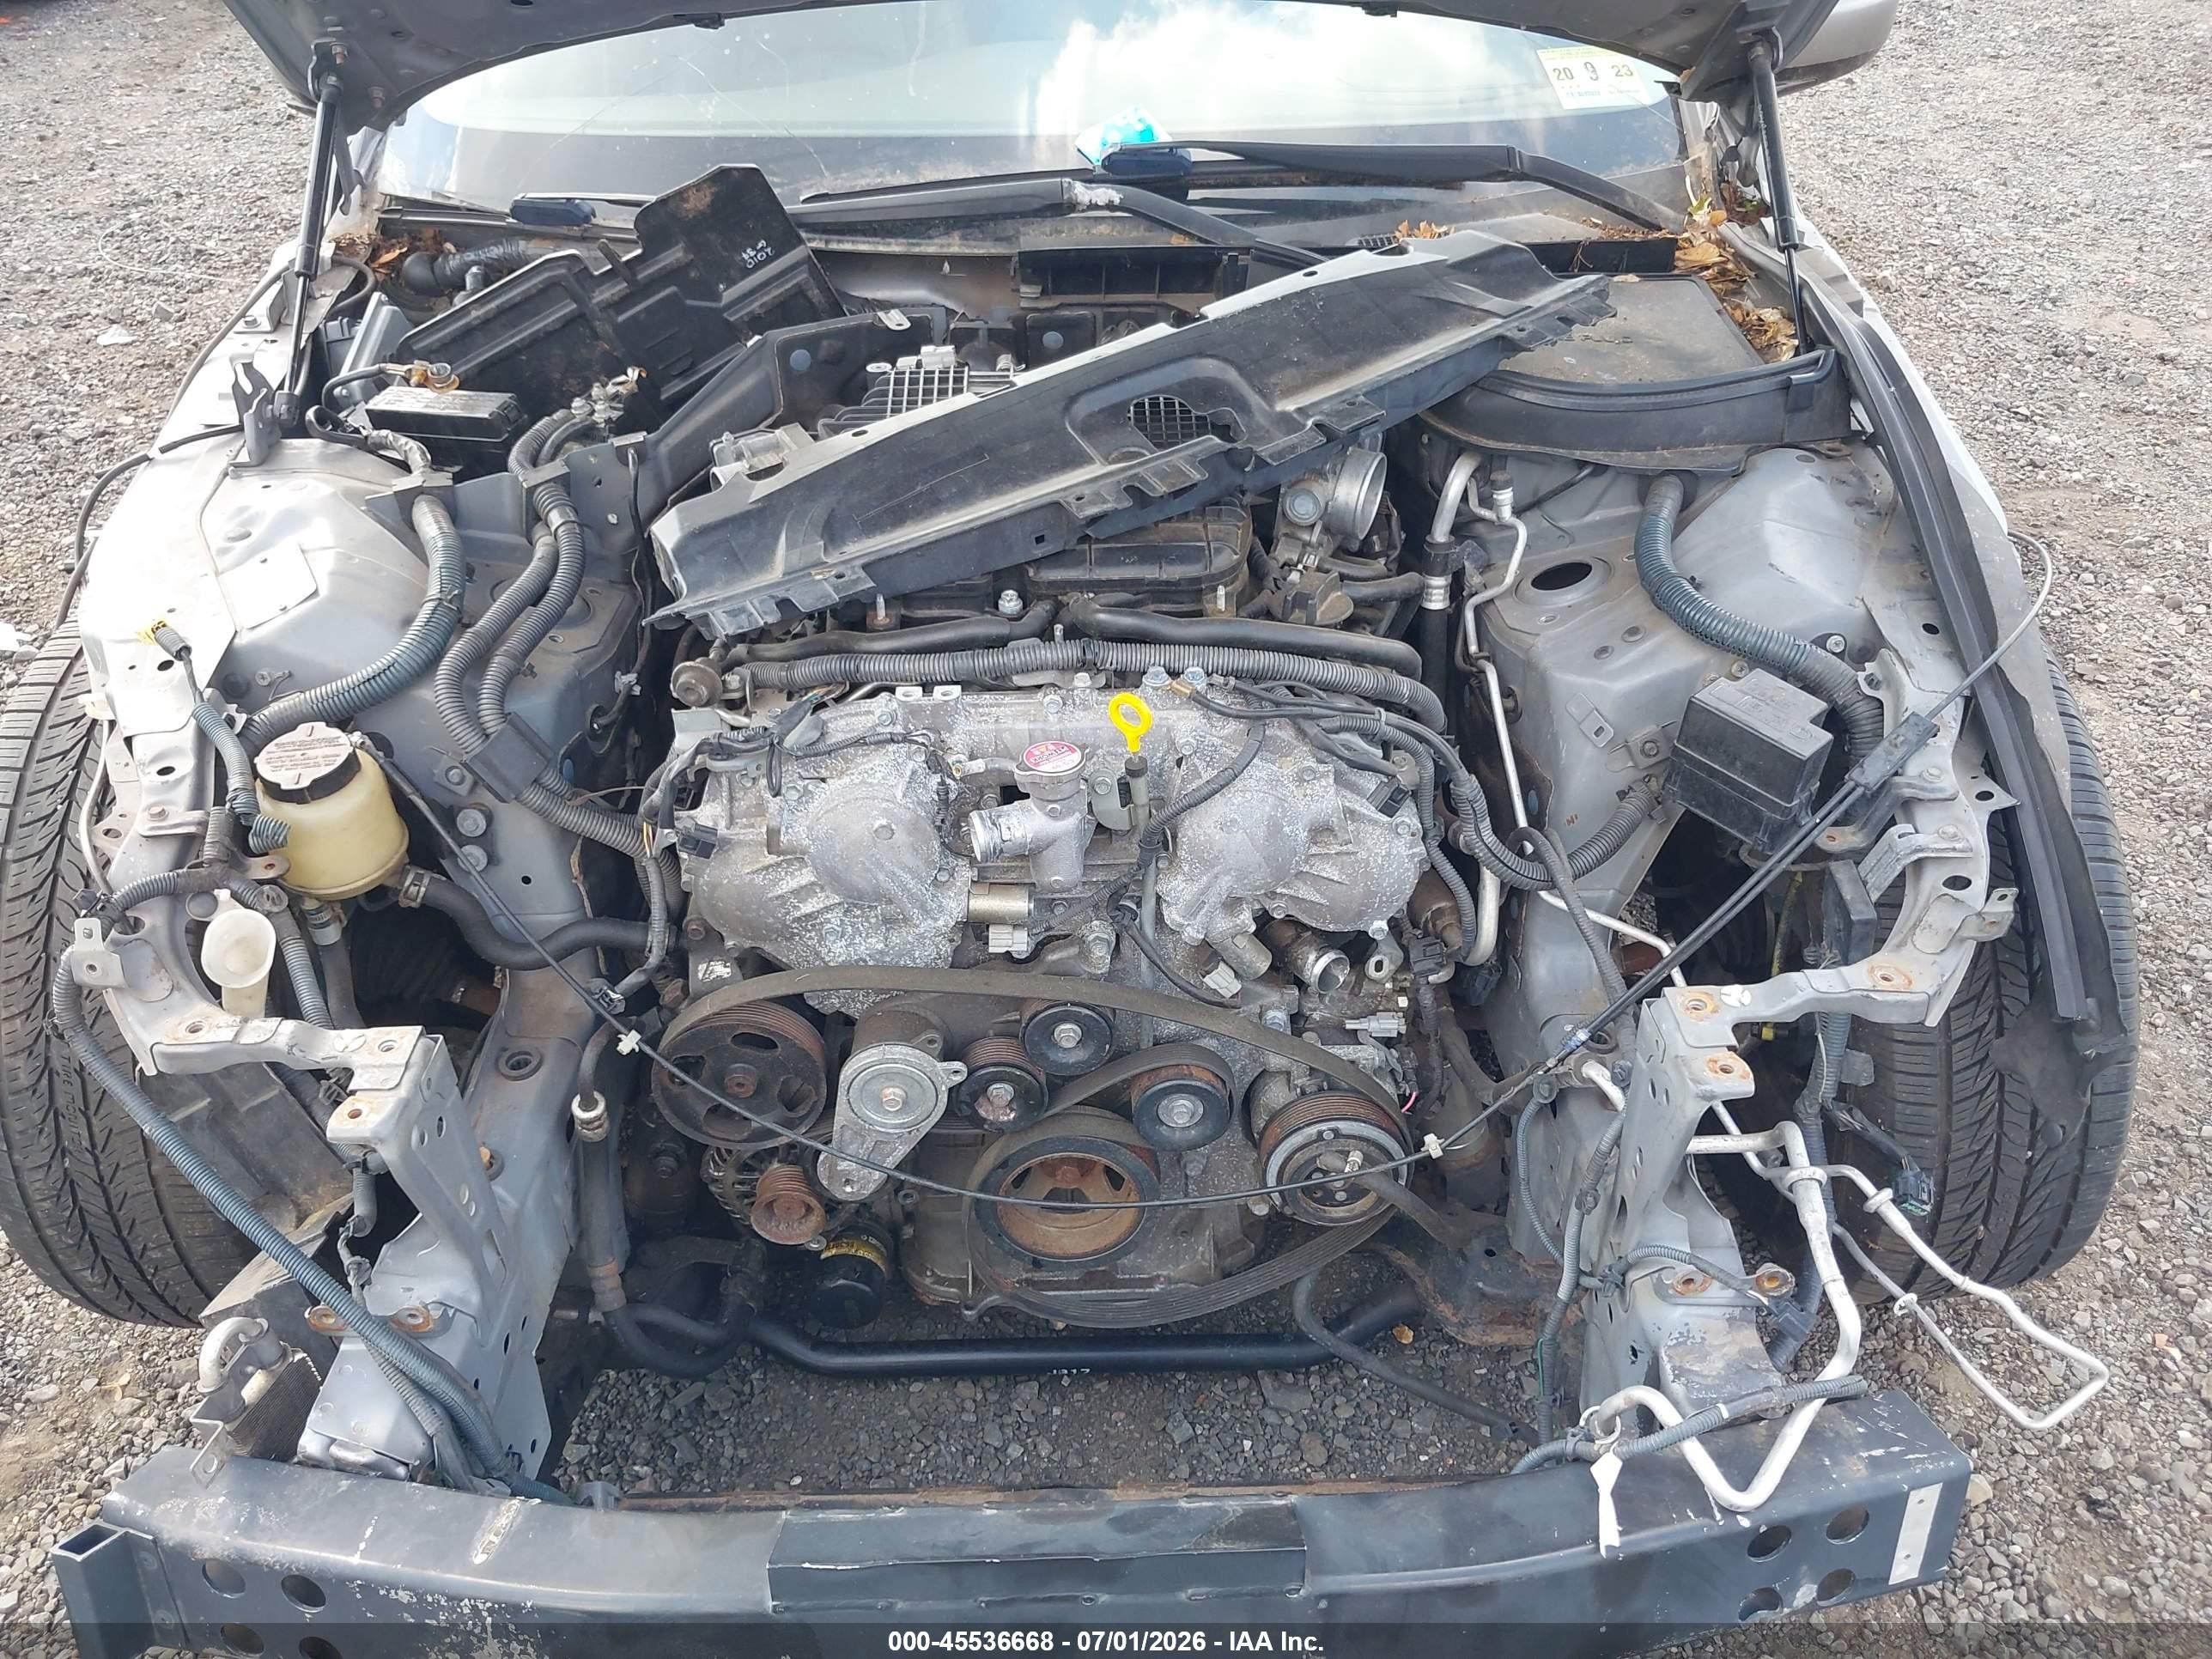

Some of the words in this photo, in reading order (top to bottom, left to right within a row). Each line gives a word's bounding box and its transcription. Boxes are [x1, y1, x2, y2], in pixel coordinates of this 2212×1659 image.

[1553, 67, 1574, 81] 20
[1583, 61, 1599, 82] 9
[1611, 64, 1633, 77] 23
[61, 1055, 74, 1087] TIRE
